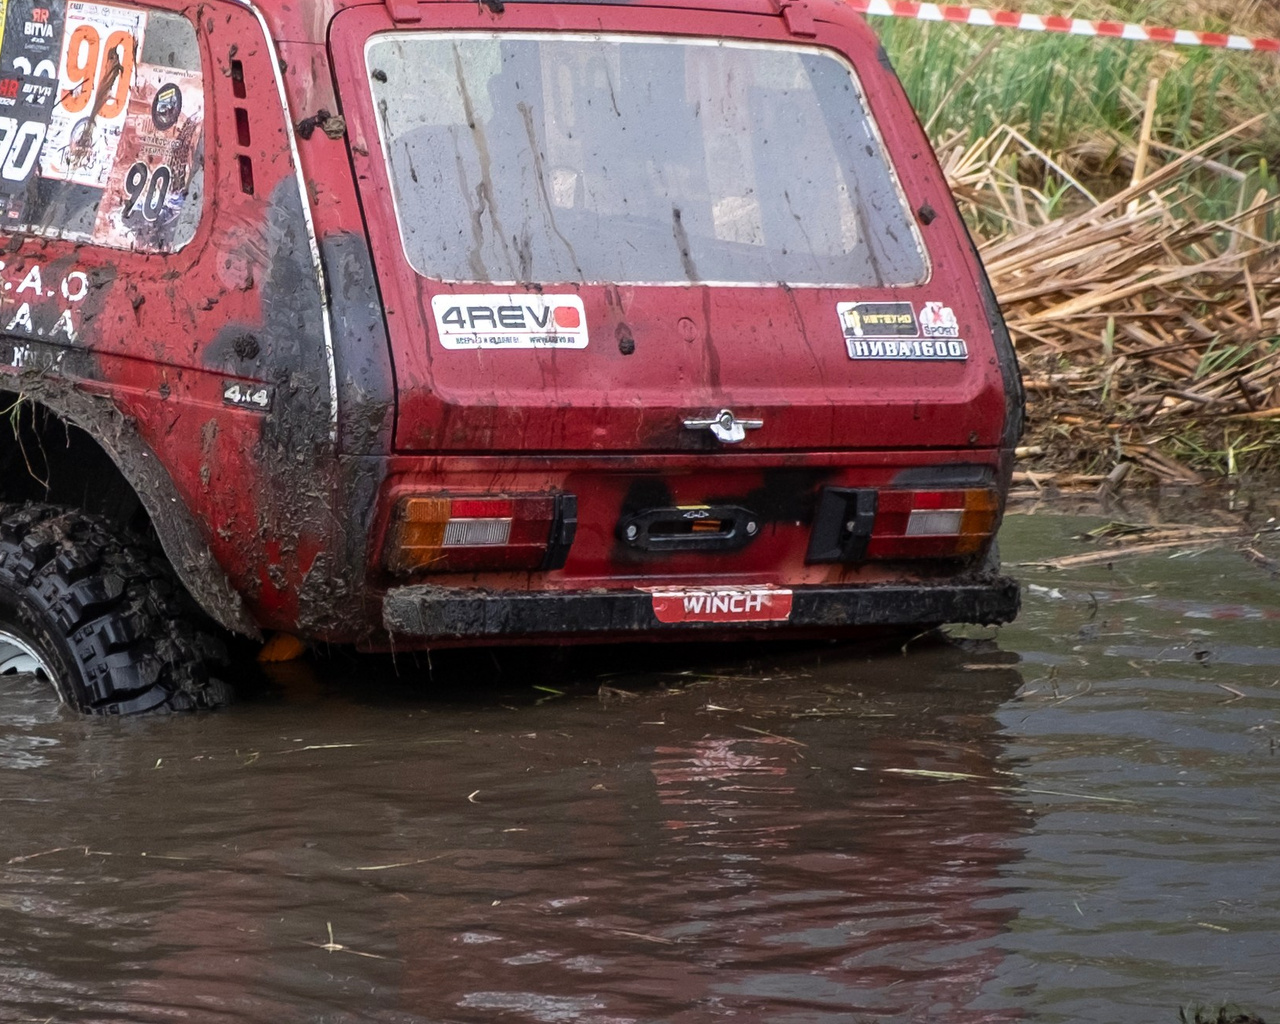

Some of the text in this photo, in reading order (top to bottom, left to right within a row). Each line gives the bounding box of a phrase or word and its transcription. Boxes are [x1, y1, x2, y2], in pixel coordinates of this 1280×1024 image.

[24, 21, 54, 38] BITVA
[60, 24, 135, 120] 90
[22, 83, 53, 97] BITVA
[24, 95, 47, 105] 44
[121, 160, 172, 222] 90
[924, 325, 958, 336] SPORT
[683, 595, 762, 614] WINCH
